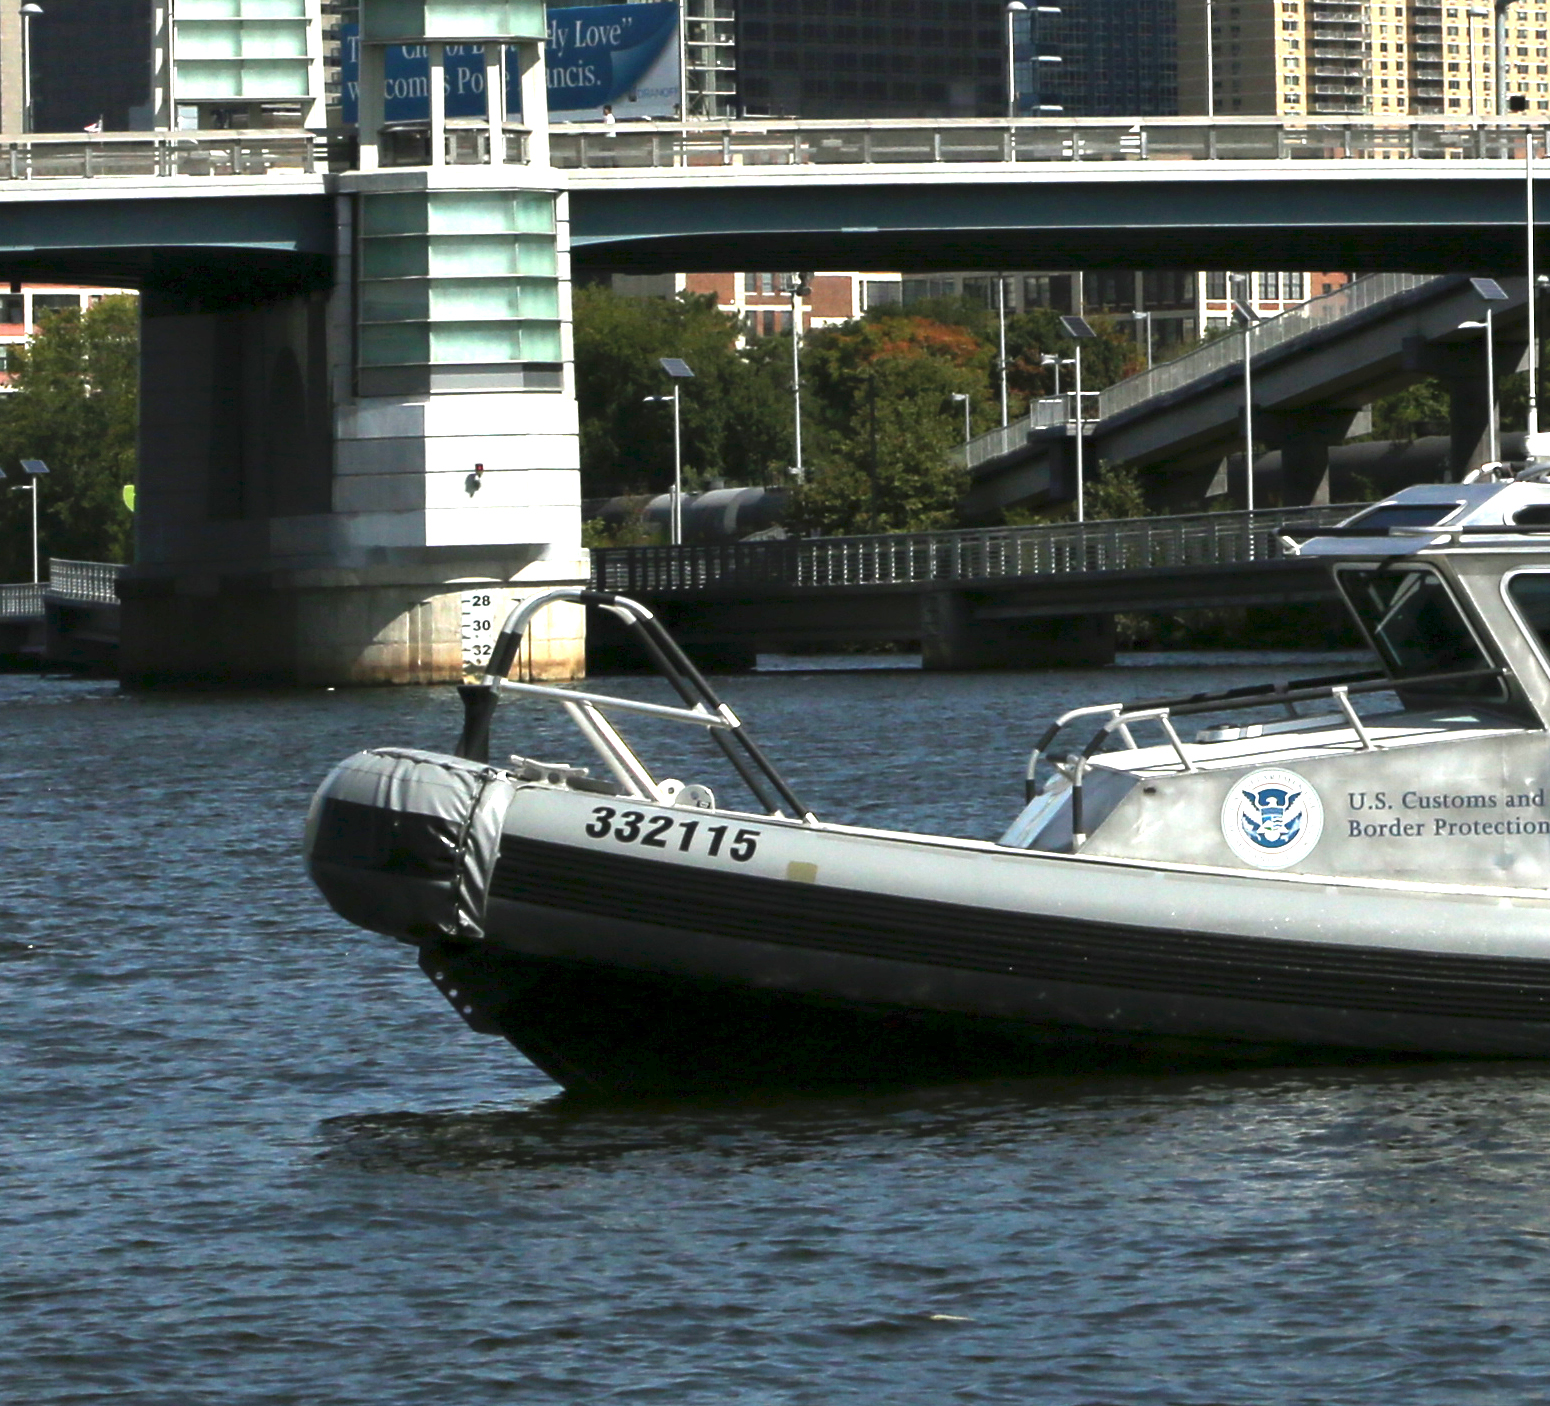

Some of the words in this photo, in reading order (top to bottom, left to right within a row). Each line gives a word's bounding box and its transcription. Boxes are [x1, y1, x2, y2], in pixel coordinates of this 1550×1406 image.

[472, 595, 491, 607] 28
[472, 620, 491, 631] 30
[472, 644, 491, 656] 32
[1348, 792, 1393, 811] U.S.
[1401, 791, 1497, 810] Customs
[1505, 788, 1545, 808] and
[585, 806, 762, 863] 332115
[1348, 817, 1425, 838] Border
[1433, 816, 1550, 837] Protection
